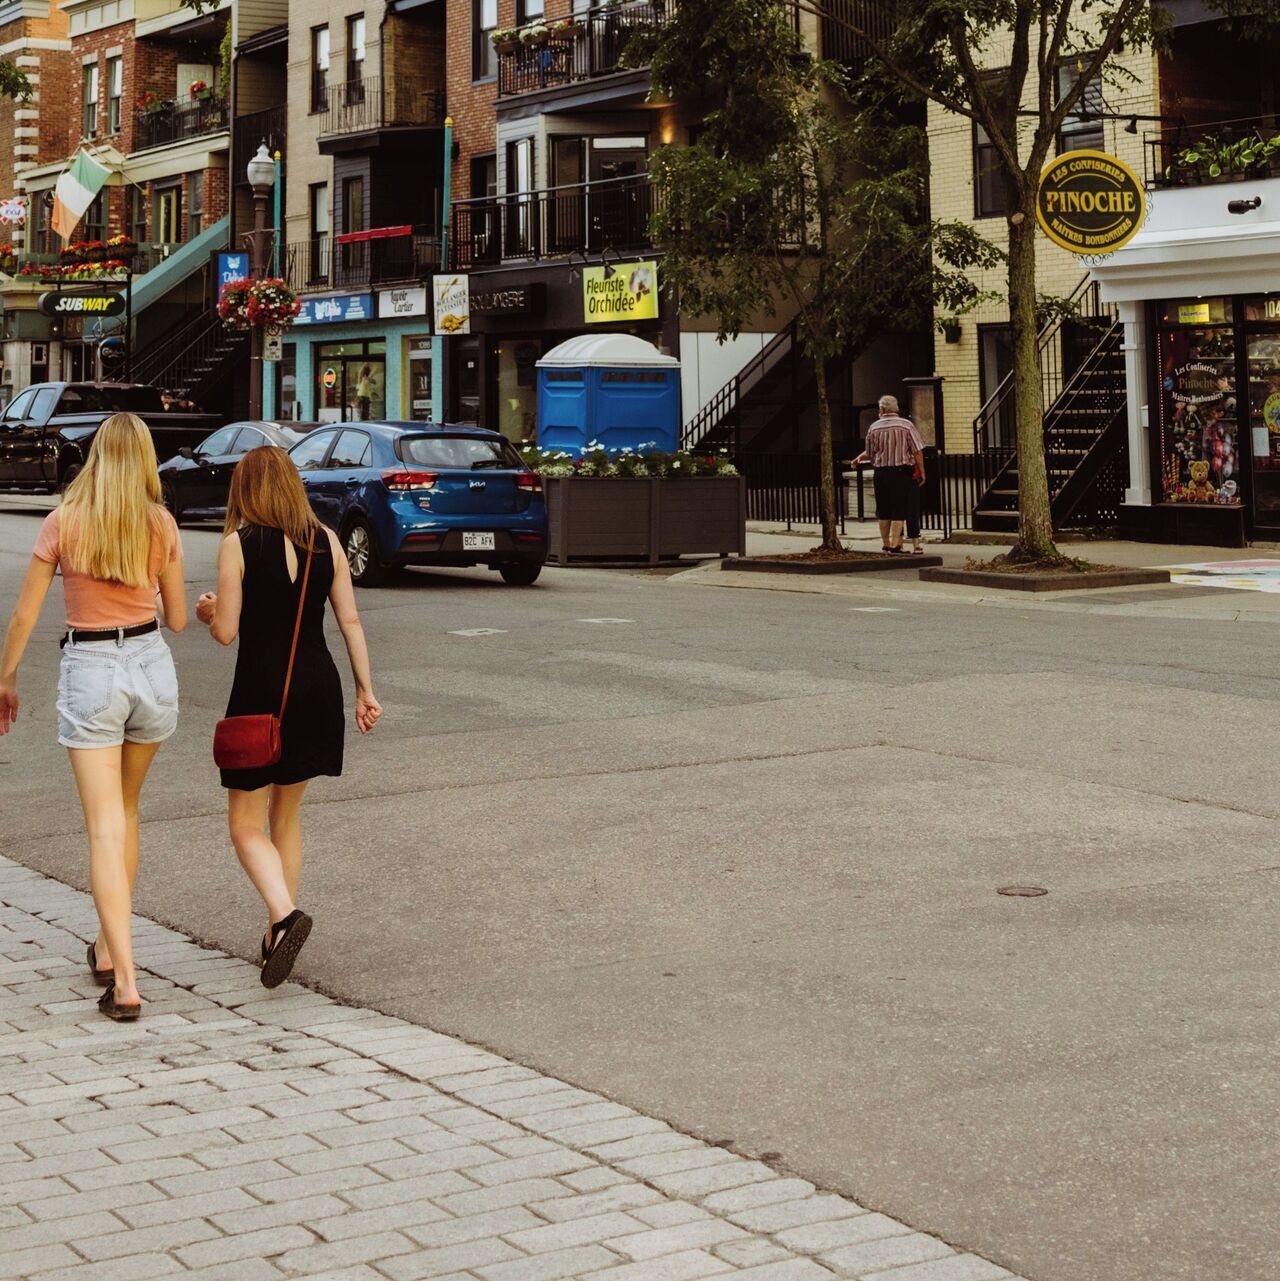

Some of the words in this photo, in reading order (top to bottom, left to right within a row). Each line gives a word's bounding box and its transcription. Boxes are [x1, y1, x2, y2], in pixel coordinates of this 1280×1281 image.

[1051, 166, 1068, 183] LES
[1069, 159, 1126, 182] CONFISERIES
[1045, 191, 1136, 213] PINOCHE
[587, 277, 624, 295] Fleuriste
[55, 297, 115, 311] SUBWAY
[589, 292, 635, 314] Orchidée
[1175, 367, 1185, 376] Les
